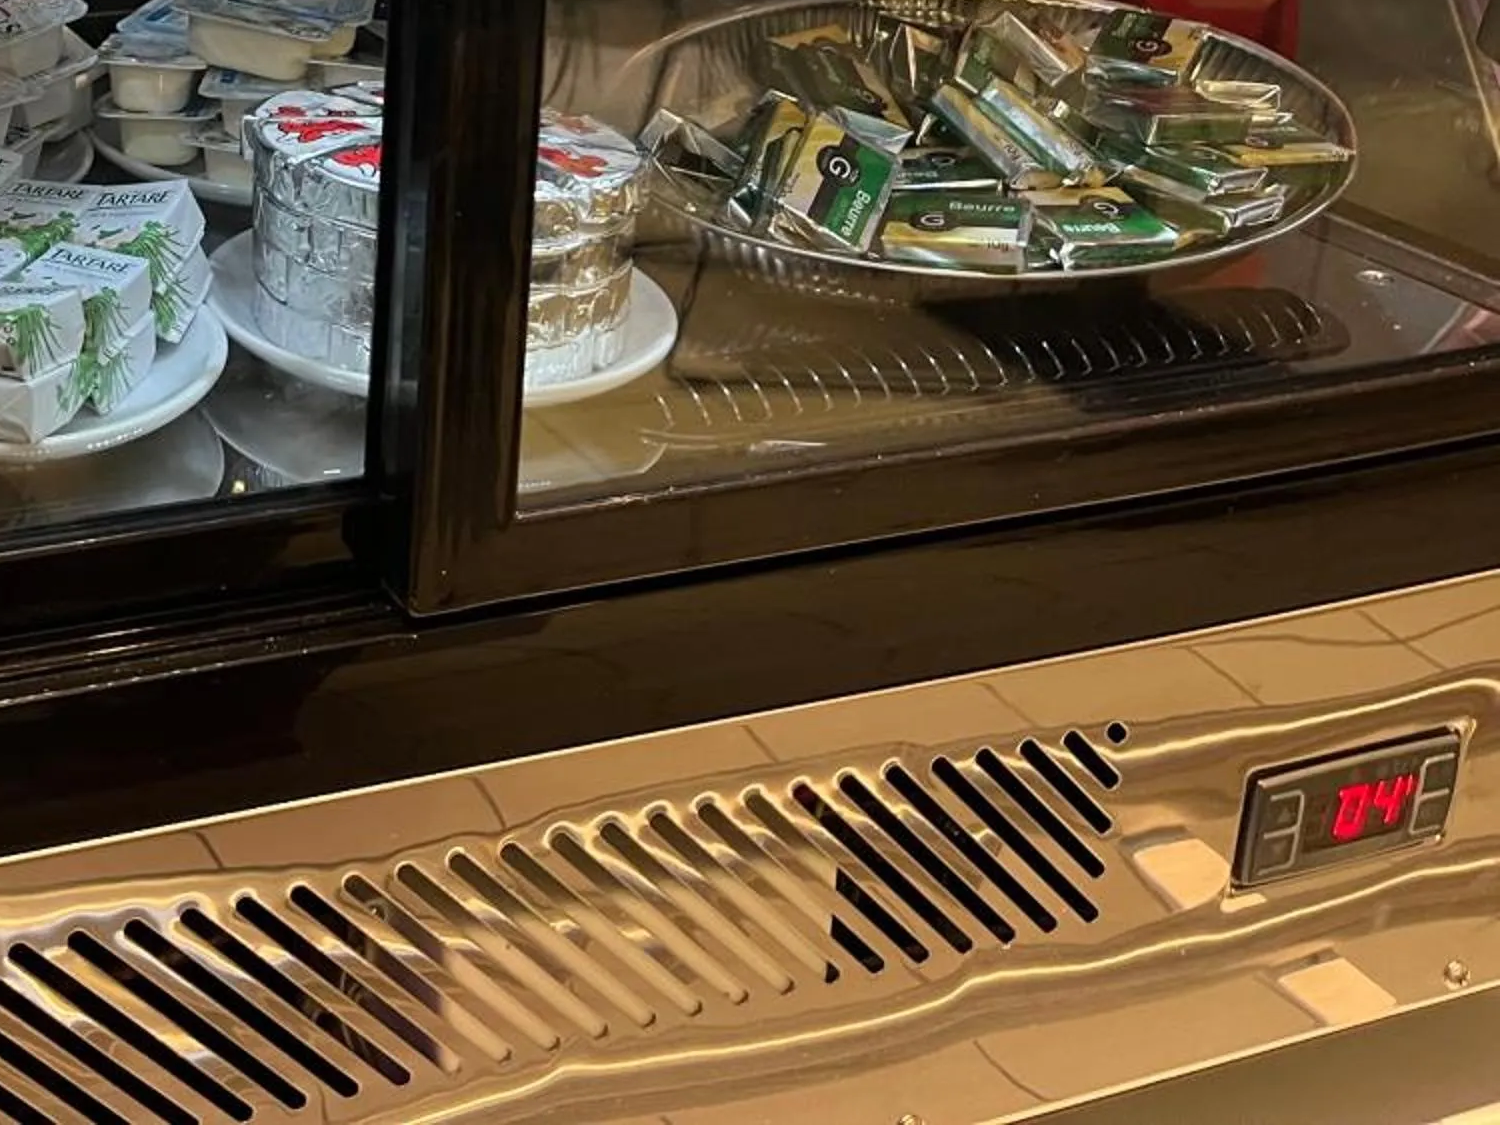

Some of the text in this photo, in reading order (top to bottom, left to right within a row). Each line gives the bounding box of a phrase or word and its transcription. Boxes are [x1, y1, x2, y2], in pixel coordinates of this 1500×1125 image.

[12, 182, 86, 201] TARTARE
[98, 190, 171, 206] TARTARE
[841, 190, 872, 237] Beurre
[949, 202, 1016, 213] Beurre
[51, 248, 130, 273] TARTARE
